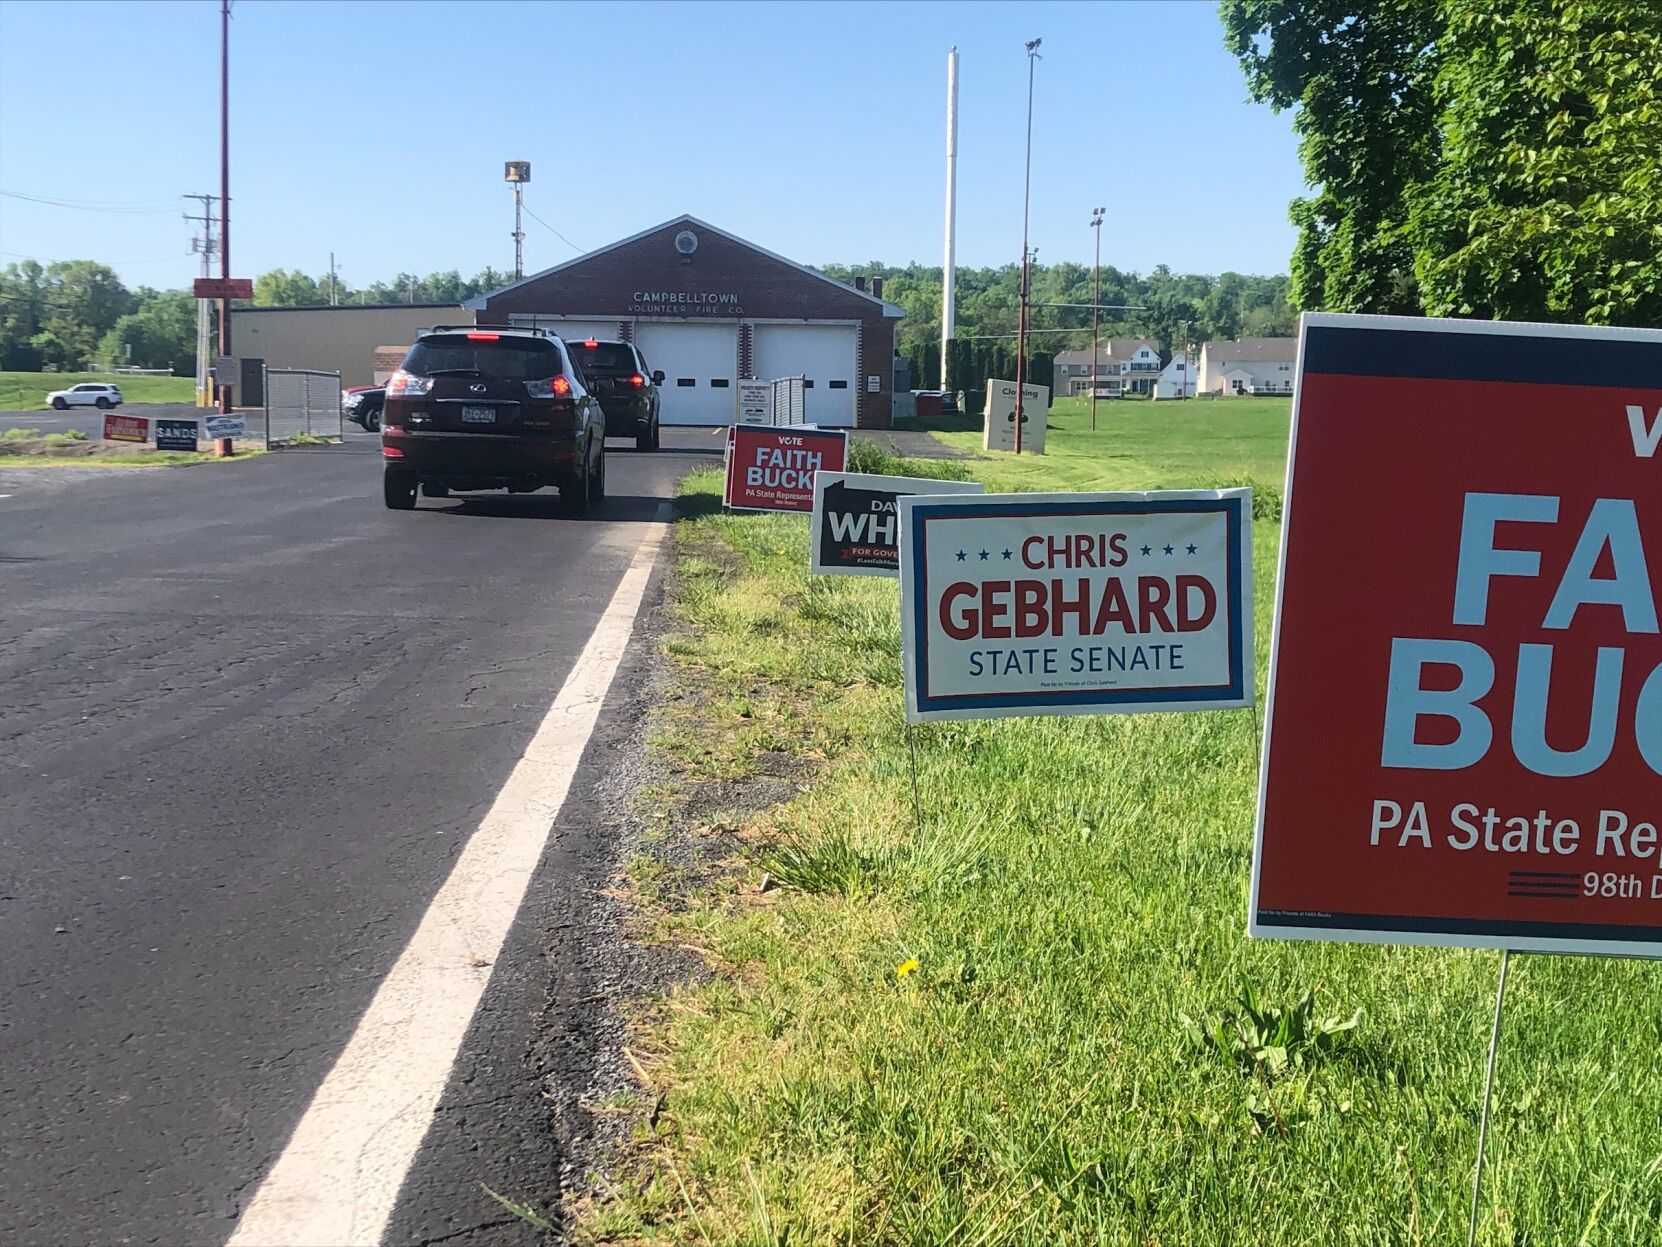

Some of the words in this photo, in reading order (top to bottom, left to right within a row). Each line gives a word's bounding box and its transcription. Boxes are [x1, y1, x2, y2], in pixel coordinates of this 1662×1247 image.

[628, 304, 686, 313] VOLUNTEER
[696, 305, 719, 314] FIRE
[633, 291, 738, 304] CAMPBELLTOWN
[1002, 387, 1038, 398] Cloing
[157, 427, 198, 439] SANDS
[778, 436, 804, 446] VOTE
[756, 447, 822, 470] FAITH
[745, 488, 755, 497] PA
[756, 489, 775, 498] State
[852, 547, 871, 555] FOR
[1021, 533, 1128, 570] CHRIS
[1452, 491, 1660, 634] FA
[939, 574, 1217, 641] GEBHARD
[969, 648, 1058, 677] STATE
[1070, 644, 1185, 673] SENATE
[1381, 637, 1662, 778] BU
[1370, 799, 1433, 848] PA
[1447, 803, 1581, 855] State
[1595, 809, 1662, 870] Re
[1582, 871, 1643, 898] 98th
